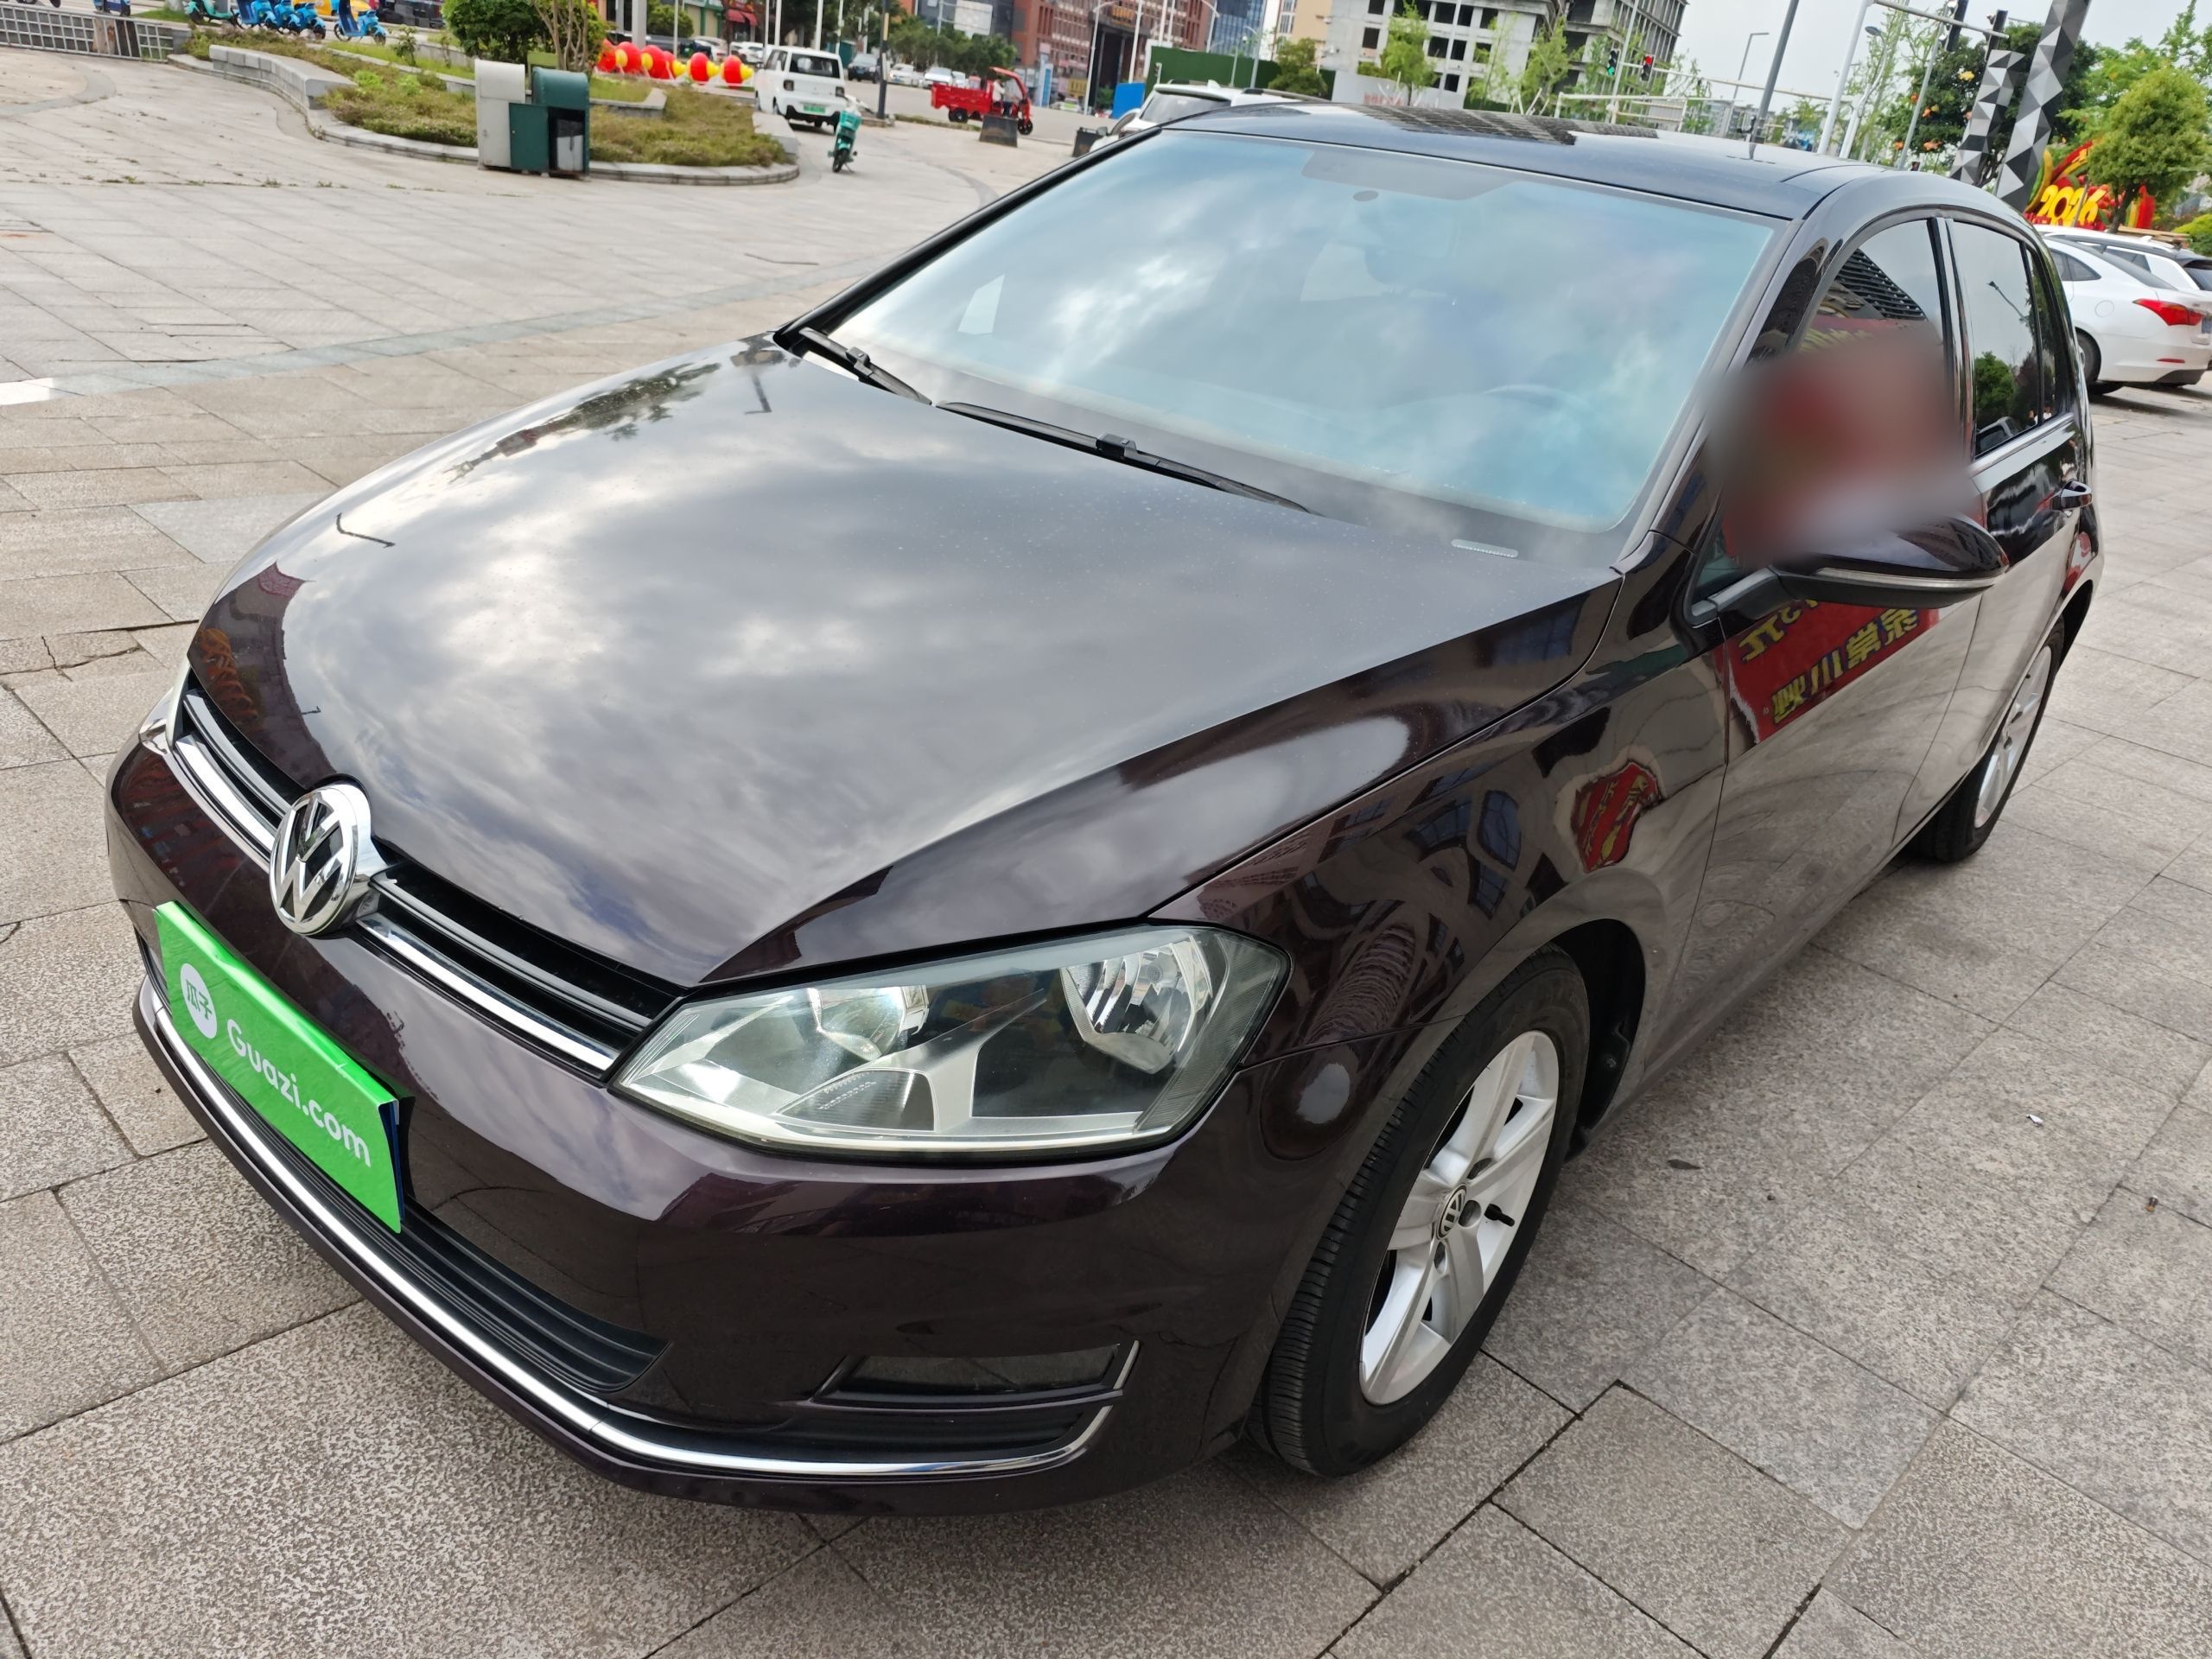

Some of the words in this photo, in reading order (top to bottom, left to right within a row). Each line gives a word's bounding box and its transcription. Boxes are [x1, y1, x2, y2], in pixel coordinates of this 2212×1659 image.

[2036, 184, 2107, 227] 2026
[186, 979, 213, 1020] 瓜子
[227, 1018, 371, 1167] Guazi.com
